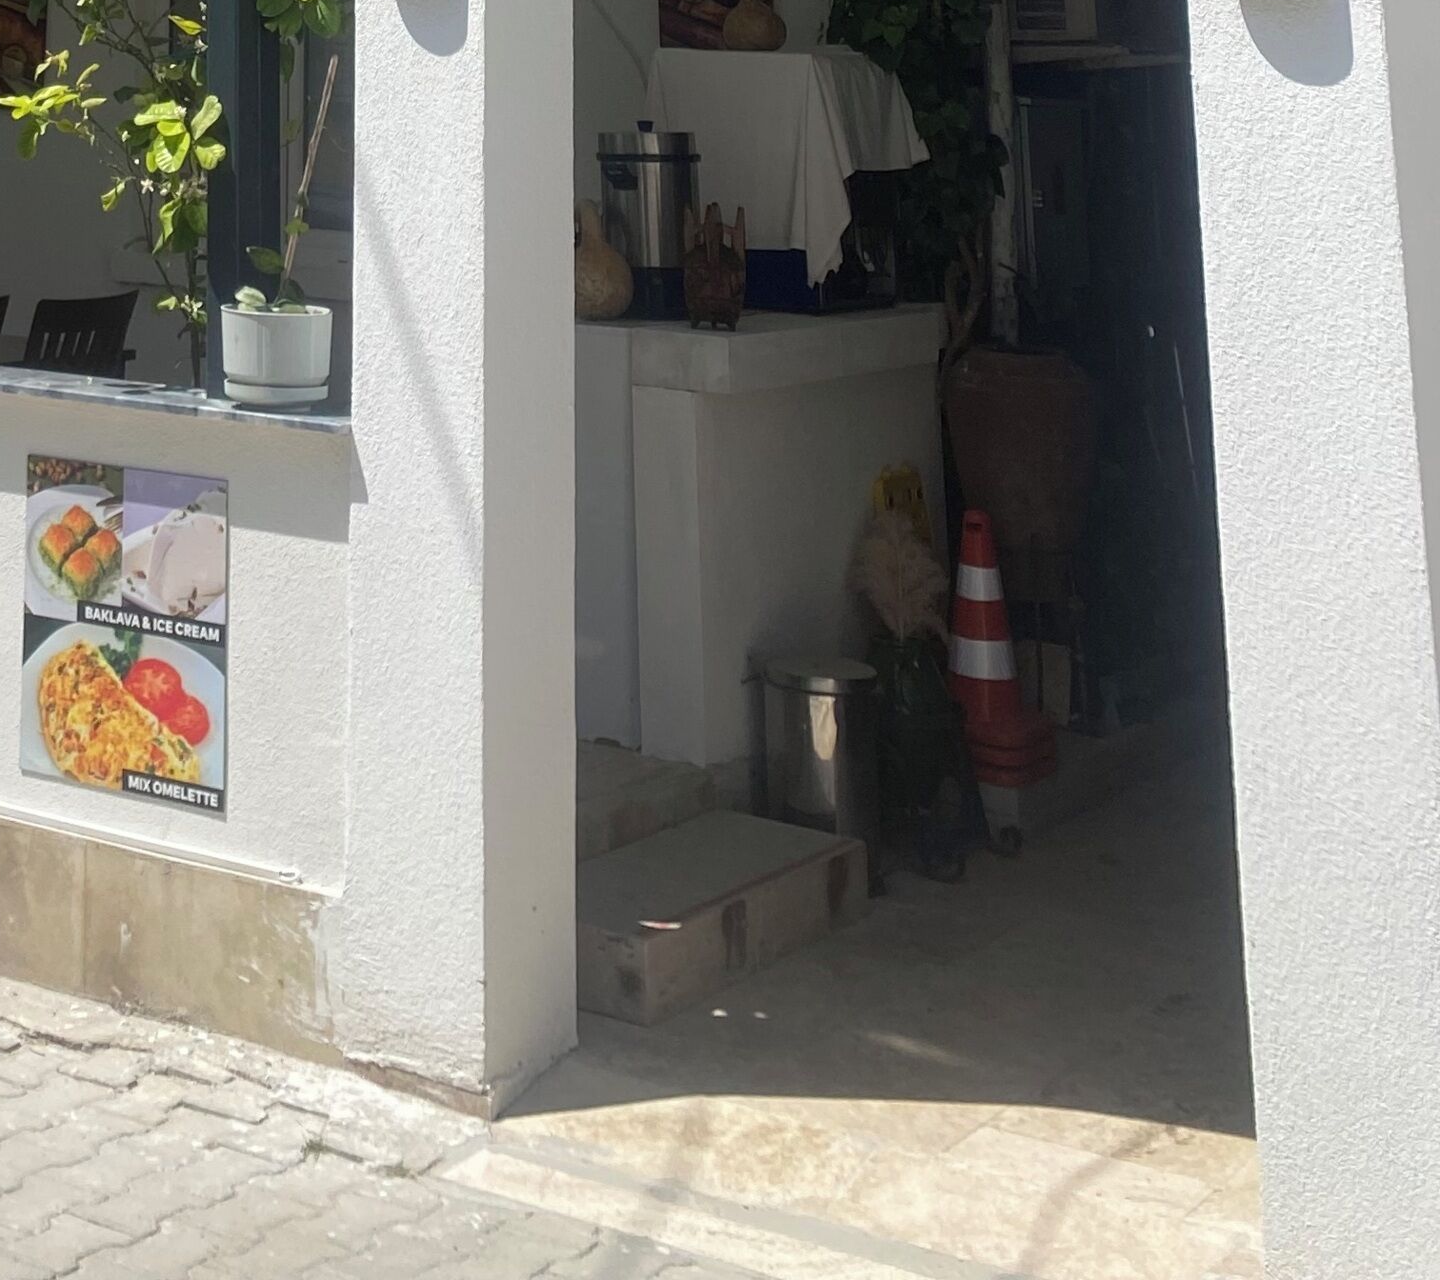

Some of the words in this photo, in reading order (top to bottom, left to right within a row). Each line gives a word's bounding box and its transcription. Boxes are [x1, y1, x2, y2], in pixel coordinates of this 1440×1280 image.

[84, 606, 140, 629] BAKLAVA
[141, 616, 151, 630] &
[153, 618, 174, 634] ICE
[174, 622, 220, 642] CREAM
[128, 775, 151, 793] MIX
[152, 781, 218, 807] OMELETTE
